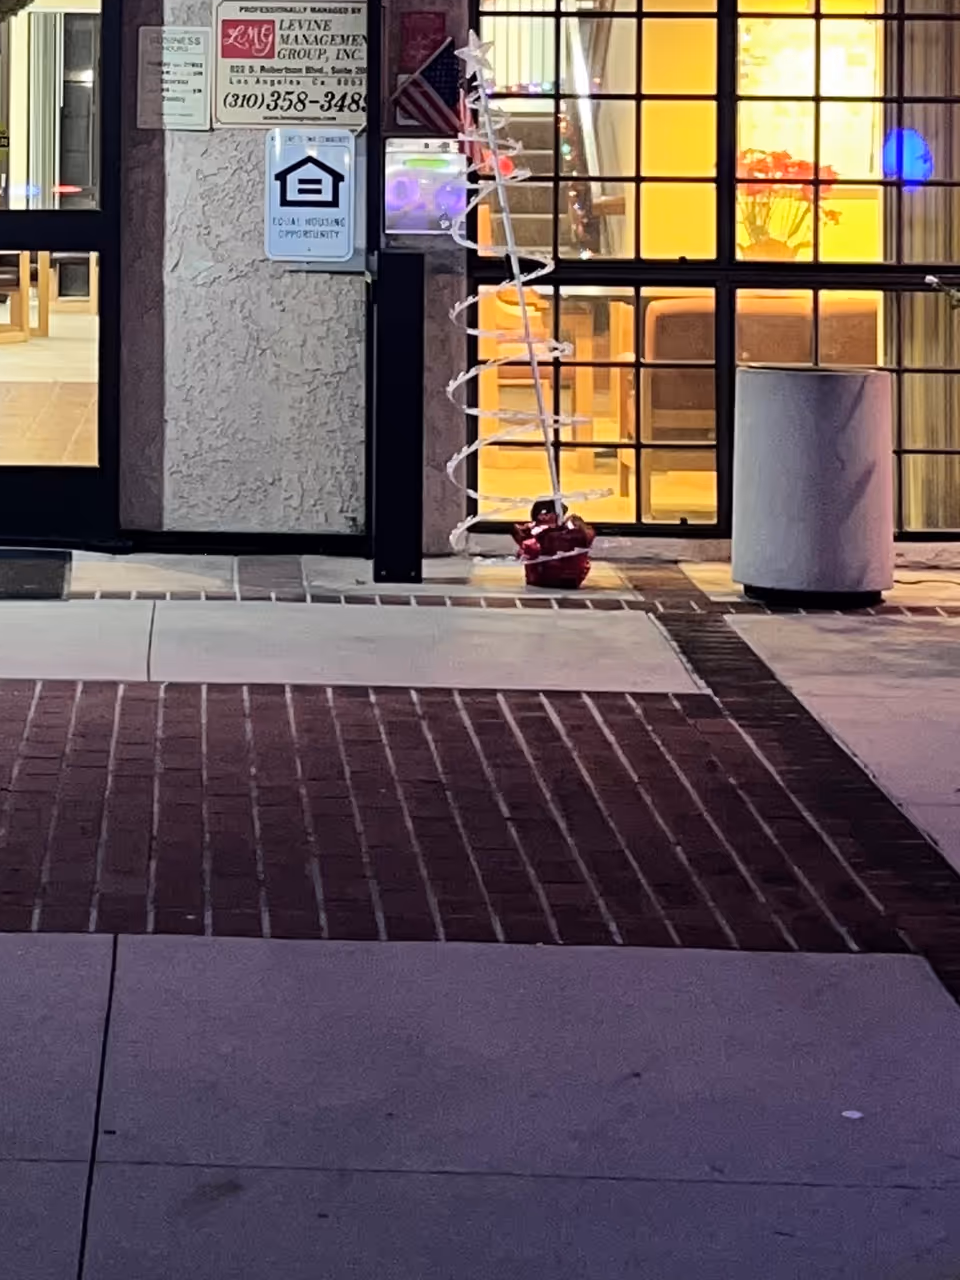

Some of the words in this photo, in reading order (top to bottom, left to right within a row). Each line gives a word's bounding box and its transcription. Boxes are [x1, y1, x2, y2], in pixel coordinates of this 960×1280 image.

[239, 6, 307, 14] PROFESSIONALLY
[310, 6, 349, 15] MANAGED
[351, 7, 362, 15] BY
[278, 19, 333, 32] LEVINE
[277, 47, 330, 62] GROUP,
[335, 48, 365, 61] INC.
[229, 78, 249, 86] Los
[254, 77, 301, 88] Angeles
[272, 216, 301, 226] EQUAL
[304, 216, 346, 228] HOUSING
[278, 229, 340, 239] OPPORTUNITY
